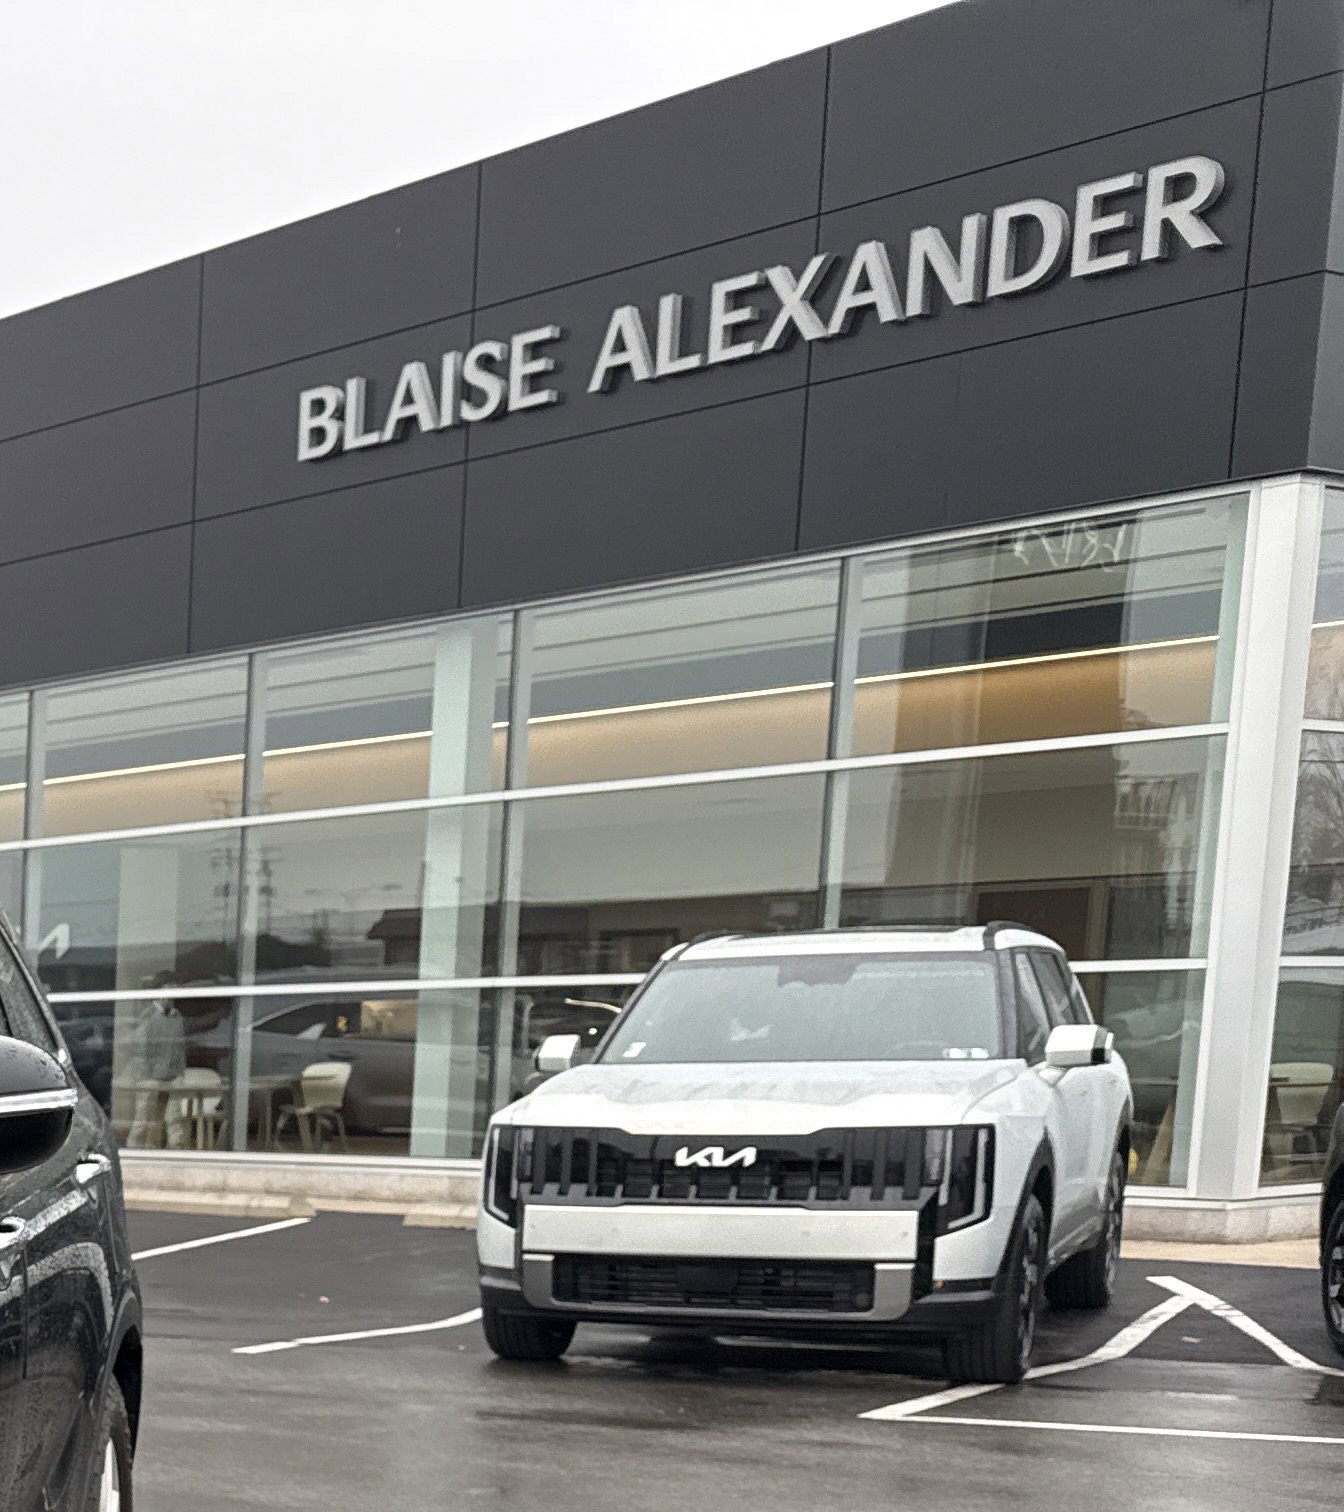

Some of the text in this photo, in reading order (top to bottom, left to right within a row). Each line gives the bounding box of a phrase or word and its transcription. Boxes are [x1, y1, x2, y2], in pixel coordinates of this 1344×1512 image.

[297, 155, 1227, 463] BLAISE ALEXANDER
[675, 1146, 757, 1168] KIA
